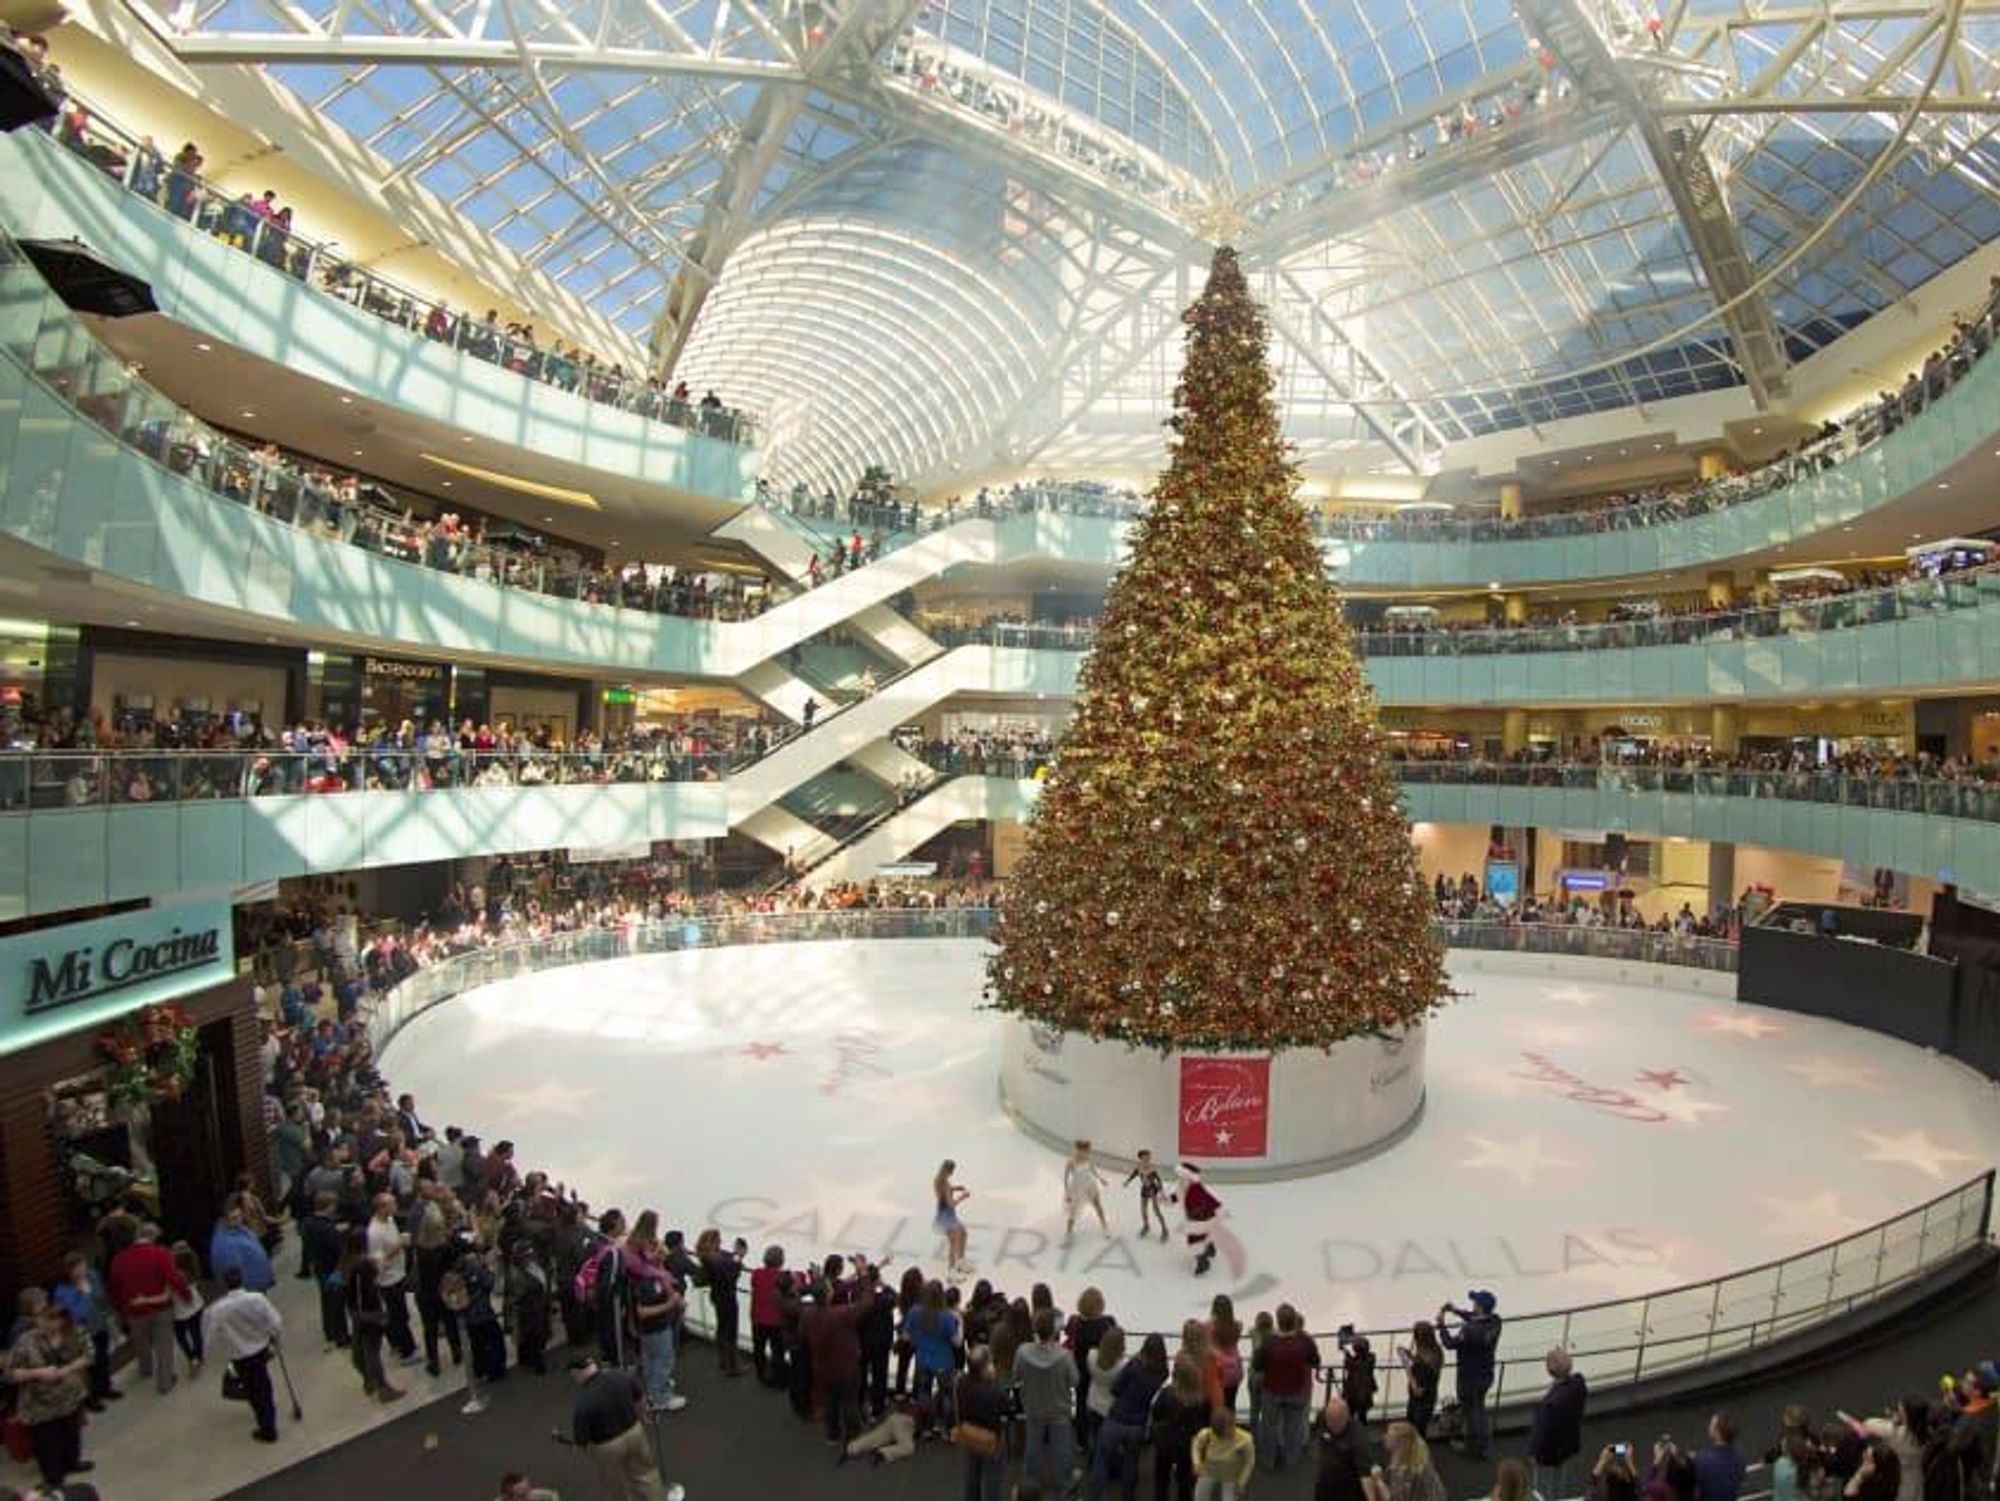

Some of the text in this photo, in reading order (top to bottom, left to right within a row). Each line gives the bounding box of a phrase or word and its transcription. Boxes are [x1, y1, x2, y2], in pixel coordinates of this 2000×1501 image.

[26, 927, 220, 1006] Mi Cocina
[707, 1196, 1663, 1284] GALLERIA DALLAS
